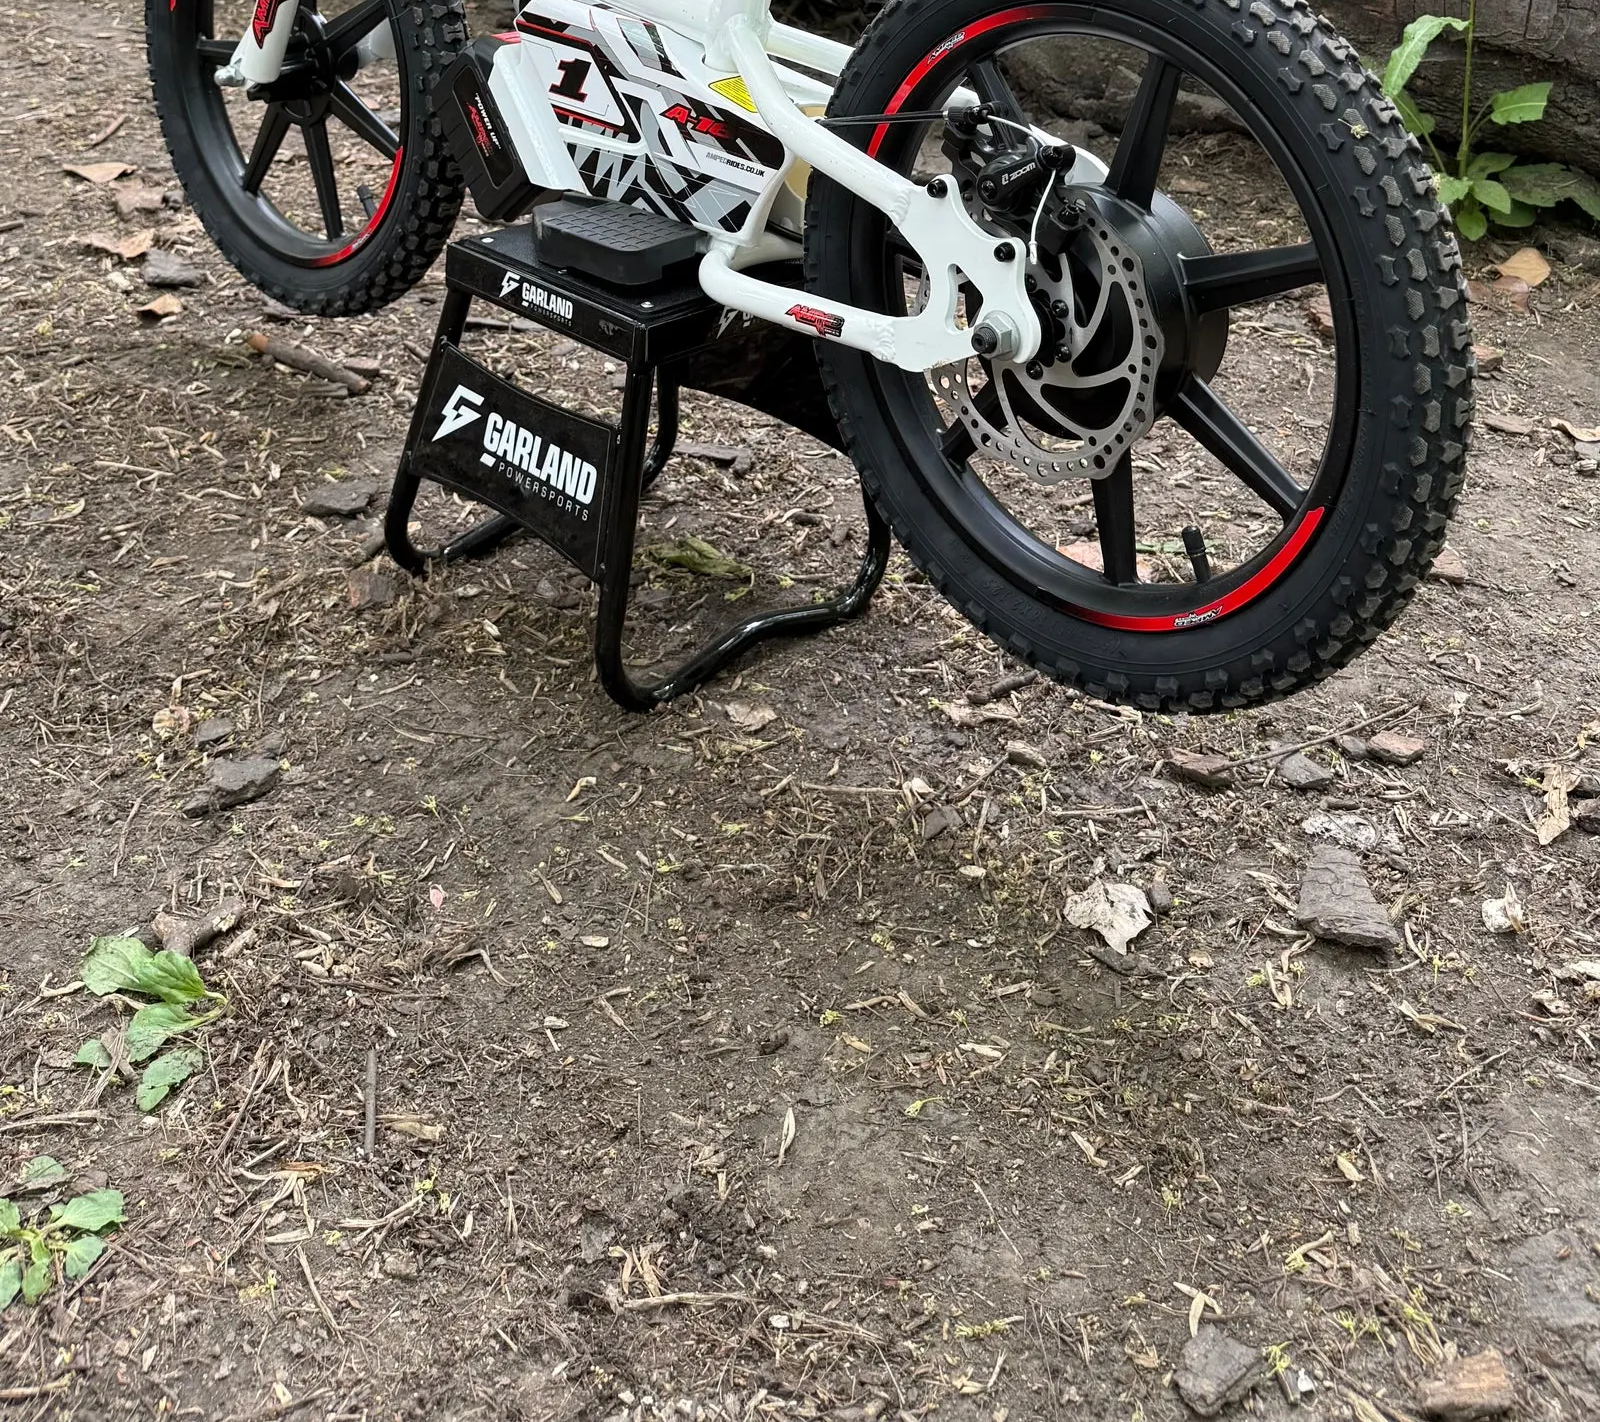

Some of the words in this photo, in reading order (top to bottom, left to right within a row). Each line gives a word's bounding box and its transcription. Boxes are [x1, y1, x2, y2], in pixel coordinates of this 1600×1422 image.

[547, 57, 593, 104] 1
[705, 151, 765, 178] AMPEDRIDES.CO.UK
[521, 282, 574, 320] GARLAND
[482, 411, 598, 506] GARLAND
[498, 462, 589, 522] POWERSPORTS
